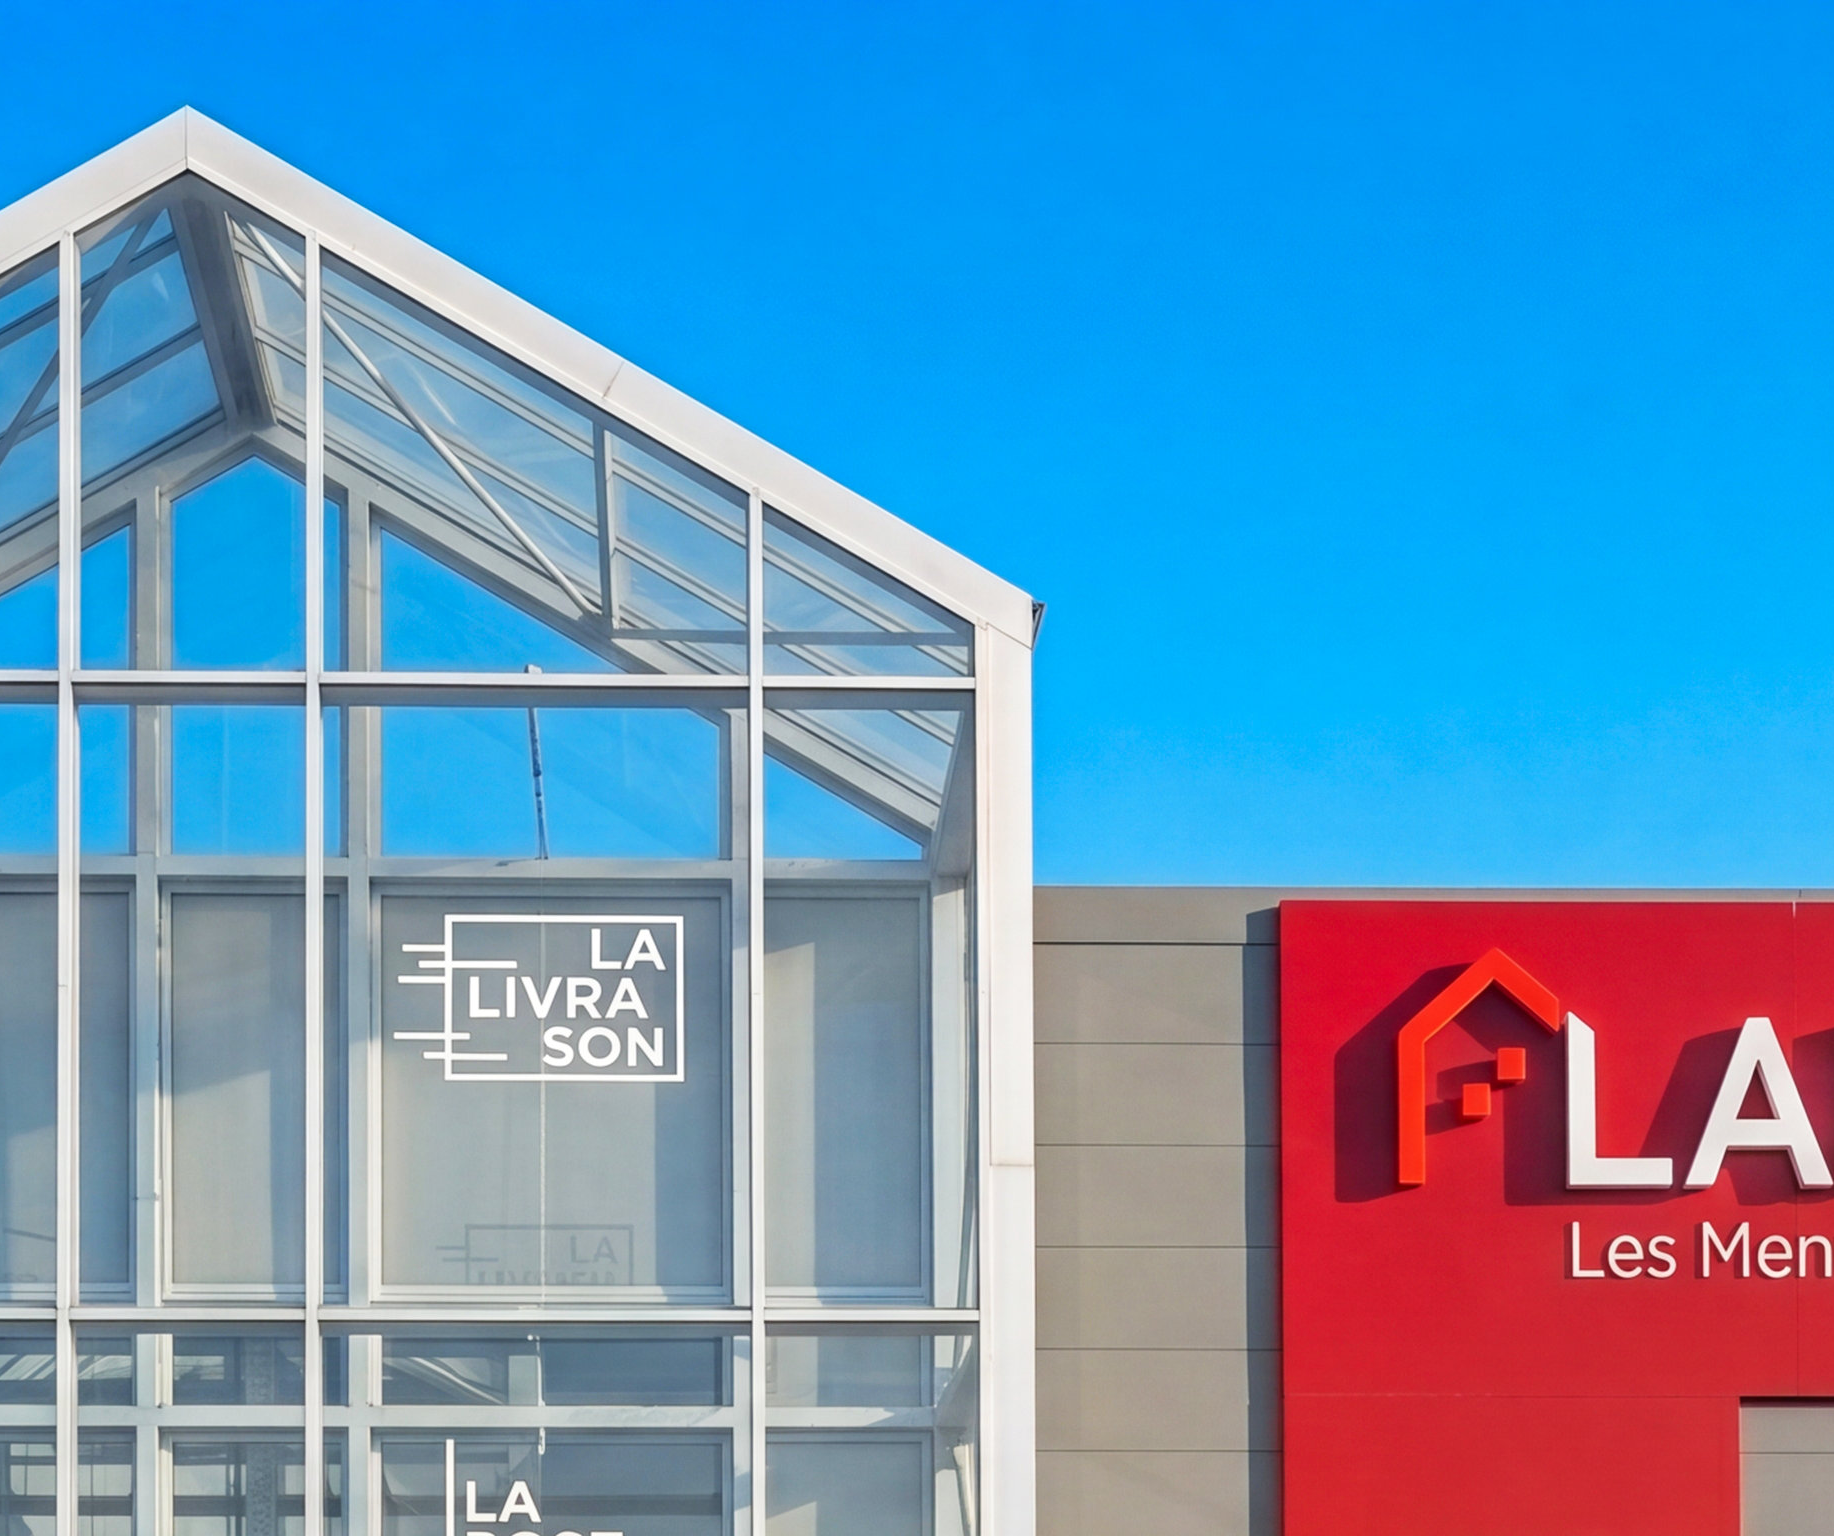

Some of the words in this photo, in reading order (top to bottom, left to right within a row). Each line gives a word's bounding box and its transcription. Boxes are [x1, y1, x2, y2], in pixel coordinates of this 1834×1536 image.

[590, 927, 667, 971] LA
[467, 974, 650, 1020] LIVRA
[539, 1024, 665, 1069] SON
[1570, 1220, 1677, 1279] Les
[465, 1479, 543, 1524] LA
